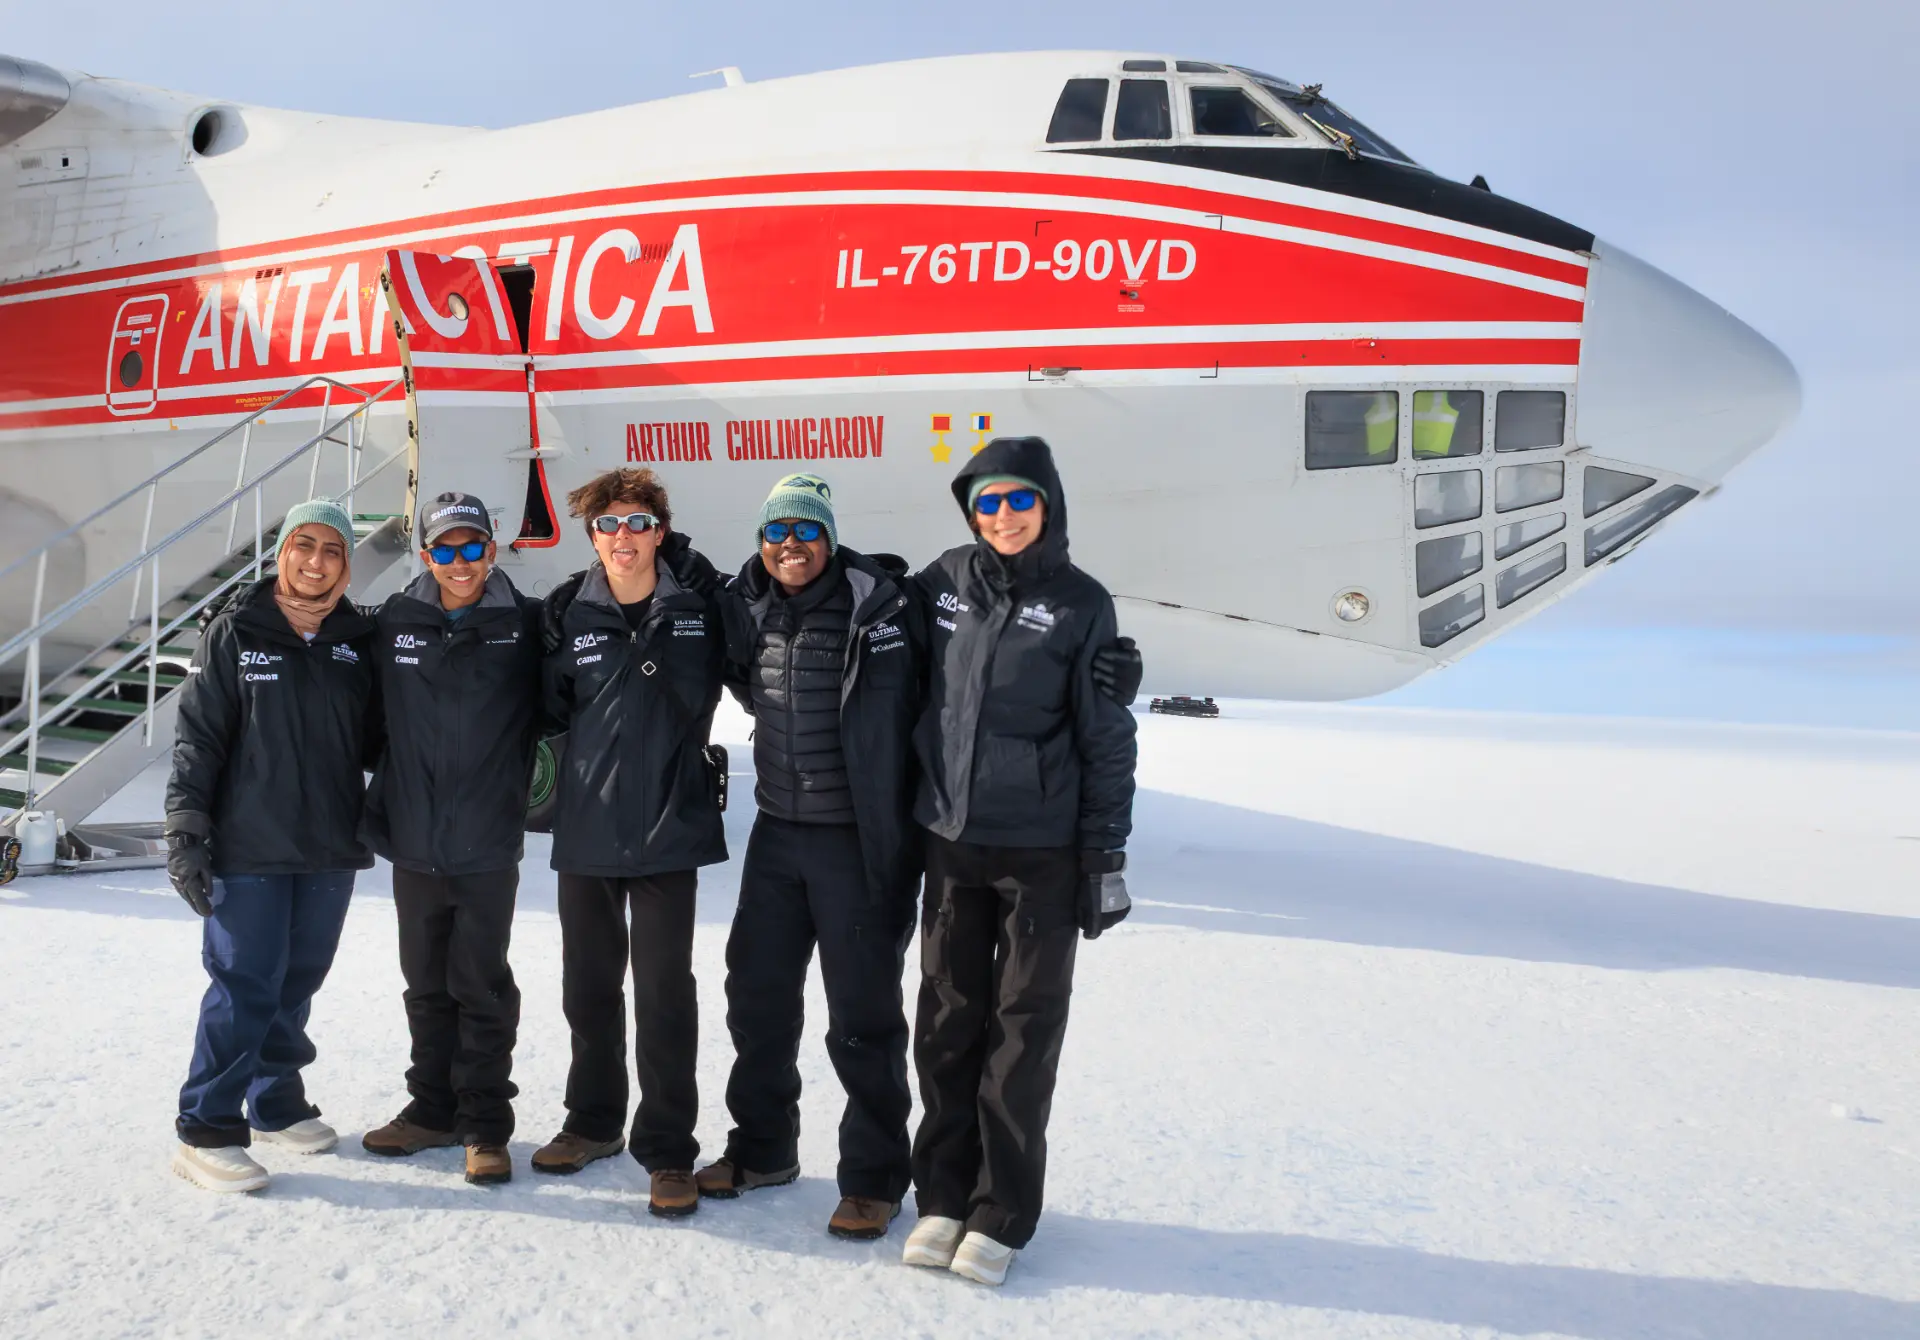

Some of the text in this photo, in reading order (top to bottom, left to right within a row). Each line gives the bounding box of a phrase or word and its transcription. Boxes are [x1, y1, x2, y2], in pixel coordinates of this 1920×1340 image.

[836, 239, 1196, 288] IL-76TD-90VD
[626, 415, 884, 462] ARTHUR CHILINGAROV
[430, 505, 480, 521] SHIMANO
[936, 592, 959, 612] SIA
[868, 625, 899, 639] ULTIMA
[394, 634, 415, 649] SIA
[573, 632, 597, 652] SIA
[876, 640, 905, 652] Columbia
[239, 651, 270, 666] SIA
[332, 645, 358, 658] ULTIMA
[395, 655, 419, 665] Canon
[576, 654, 602, 666] Canon
[245, 673, 279, 682] Canon
